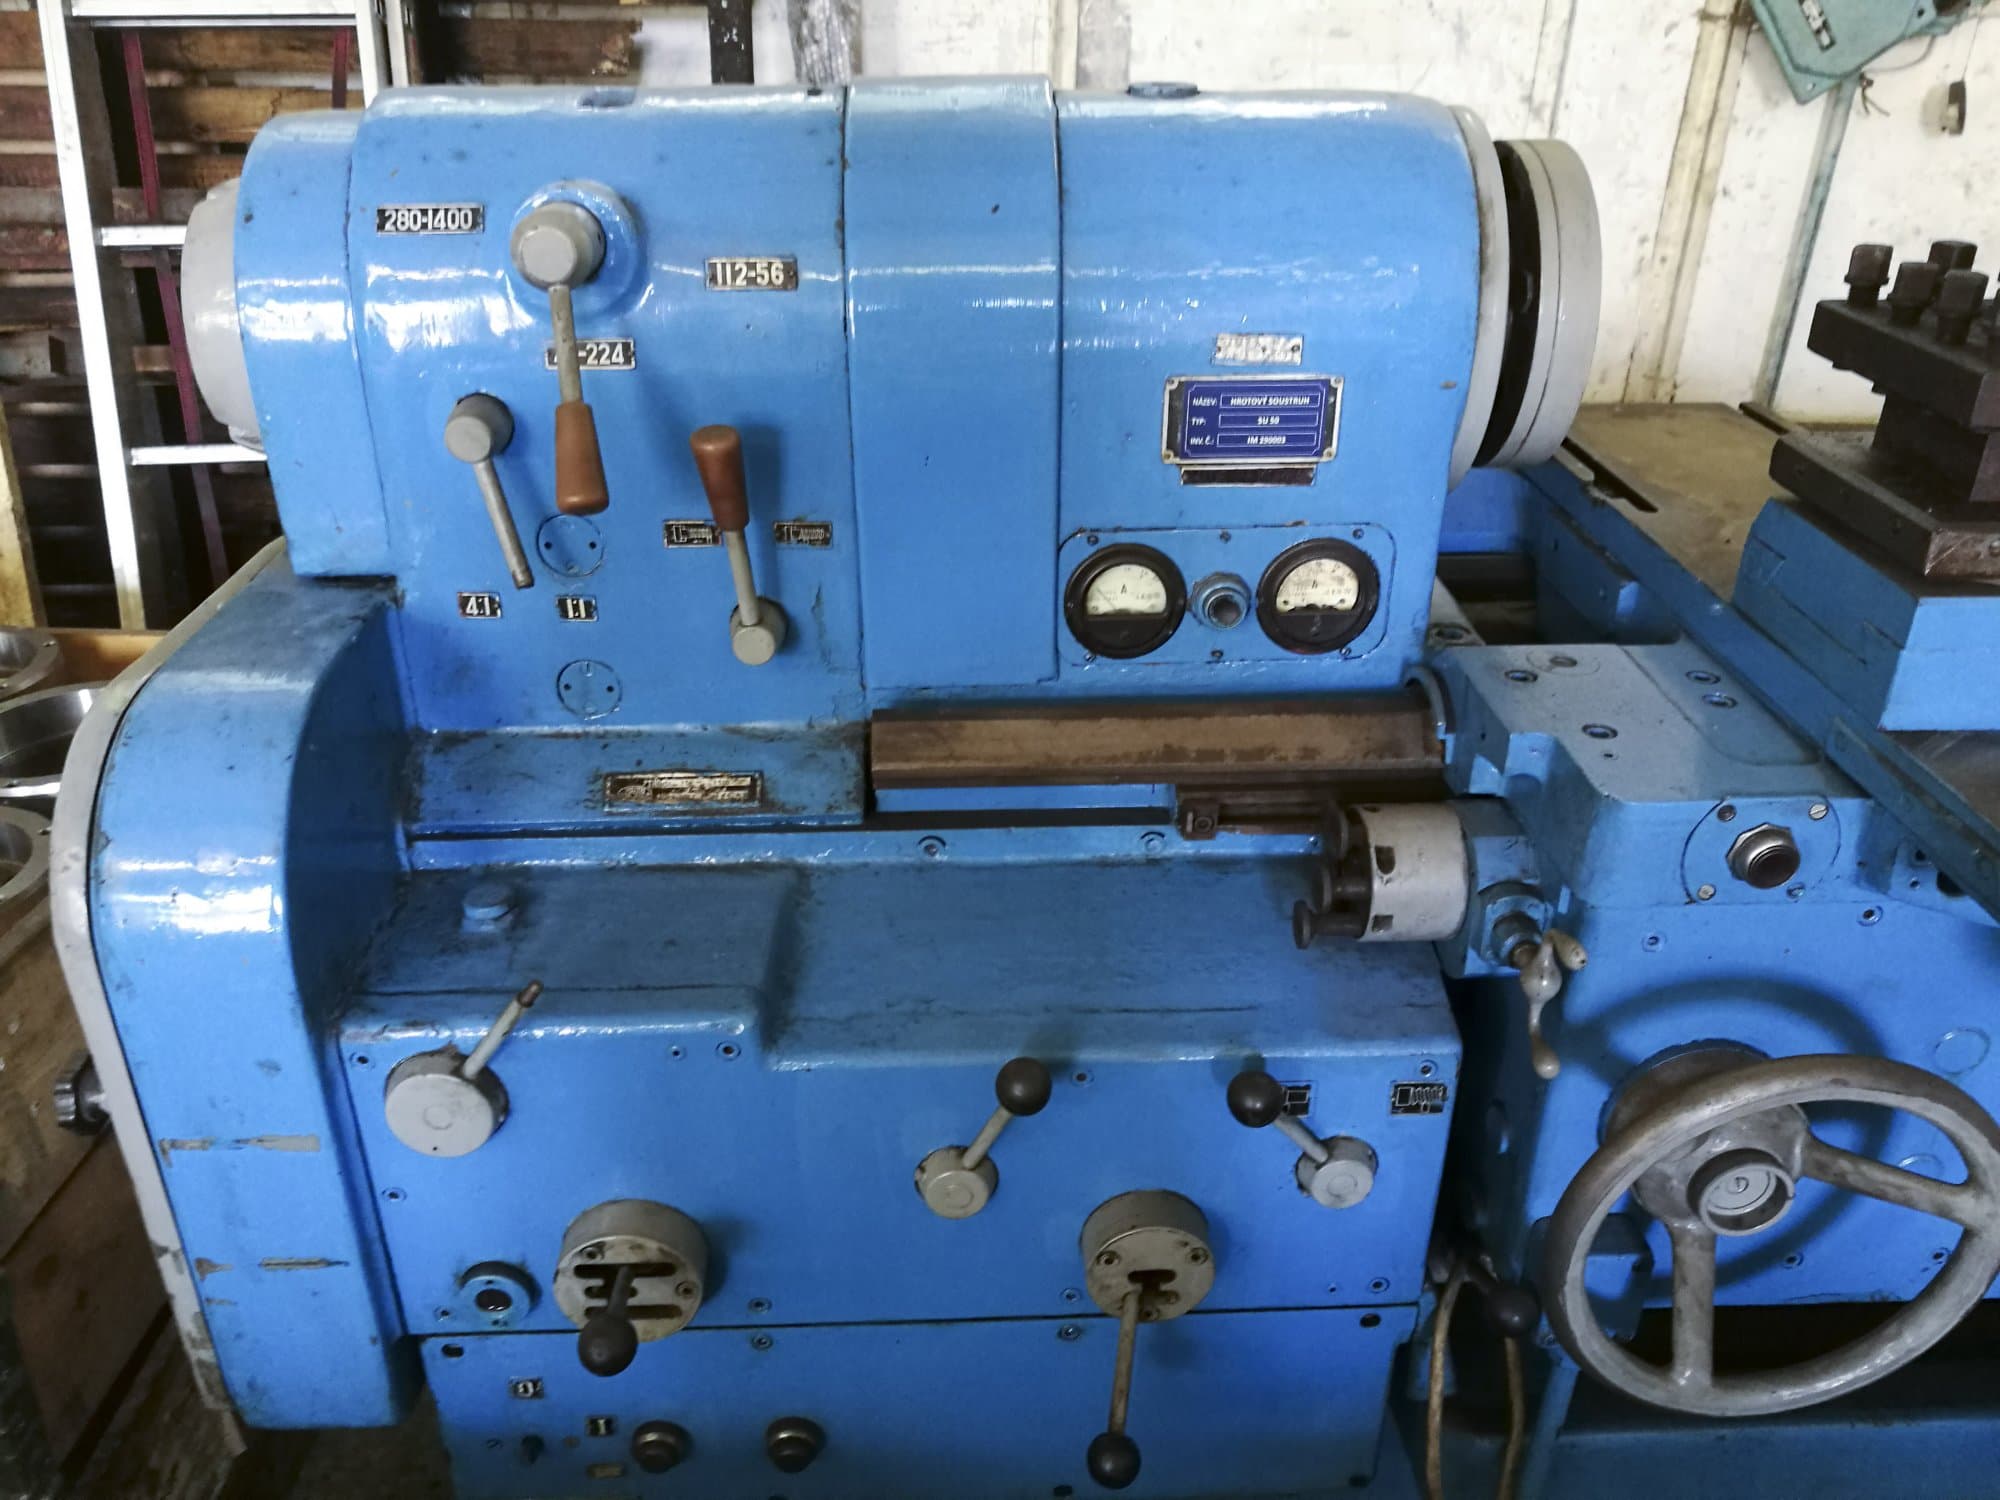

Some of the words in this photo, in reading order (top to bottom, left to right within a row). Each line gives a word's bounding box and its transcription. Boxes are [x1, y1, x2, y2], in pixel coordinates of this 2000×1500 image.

[384, 208, 473, 232] 280-1400
[716, 262, 784, 286] 112-56
[552, 342, 625, 366] -224
[465, 596, 491, 616] 4:1
